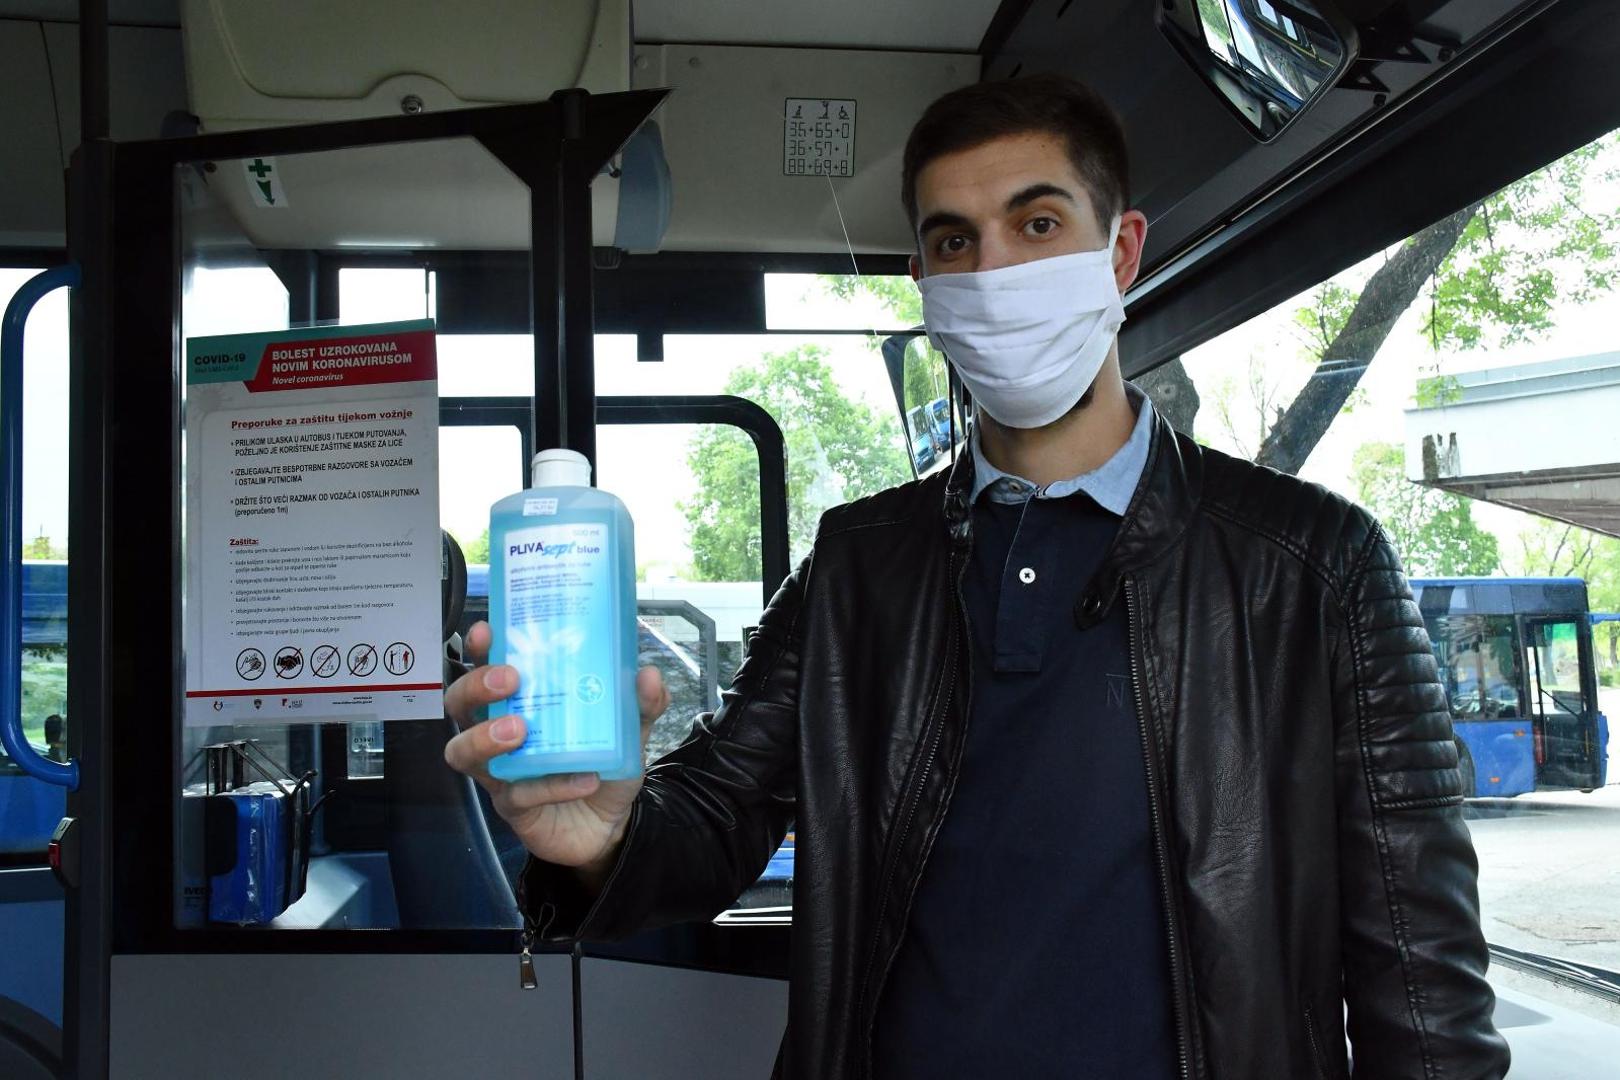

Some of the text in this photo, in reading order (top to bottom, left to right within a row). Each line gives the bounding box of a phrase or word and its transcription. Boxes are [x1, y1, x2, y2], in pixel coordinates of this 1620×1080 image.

[194, 353, 247, 366] COVID-19
[272, 342, 398, 360] BOLEST UZROKOVANA
[272, 353, 412, 373] NOVIM KORONAVIRUSOM
[272, 372, 344, 386] Novel coronavirus
[231, 409, 414, 430] Preporuke za zaštitu tijekom vožnje
[235, 437, 266, 447] PRILIKOM
[266, 435, 294, 445] ULASKA
[294, 435, 300, 443] U
[300, 432, 332, 442] AUTOBUS
[335, 431, 365, 440] TIJEKOM
[235, 438, 404, 457] POŽELJNO JE KORIŠTENJE ZAŠTITNE MASKE ZA LICE
[235, 466, 282, 477] IZBJEGAVAJTE
[327, 461, 369, 471] RAZGOVORE
[370, 460, 380, 468] SA
[380, 457, 414, 467] VOZAČEM
[238, 476, 267, 486] OSTALIM
[267, 474, 303, 484] PUTNICIMA
[234, 496, 258, 506] DRŽITE
[258, 495, 273, 505] ŠTO
[289, 493, 318, 503] RAZMAK
[318, 492, 329, 501] OD
[329, 489, 357, 501] VOZAČA
[360, 489, 390, 499] OSTALIH
[390, 488, 421, 498] PUTNIKA
[229, 536, 259, 547] Zaštita:
[576, 545, 600, 554] blue
